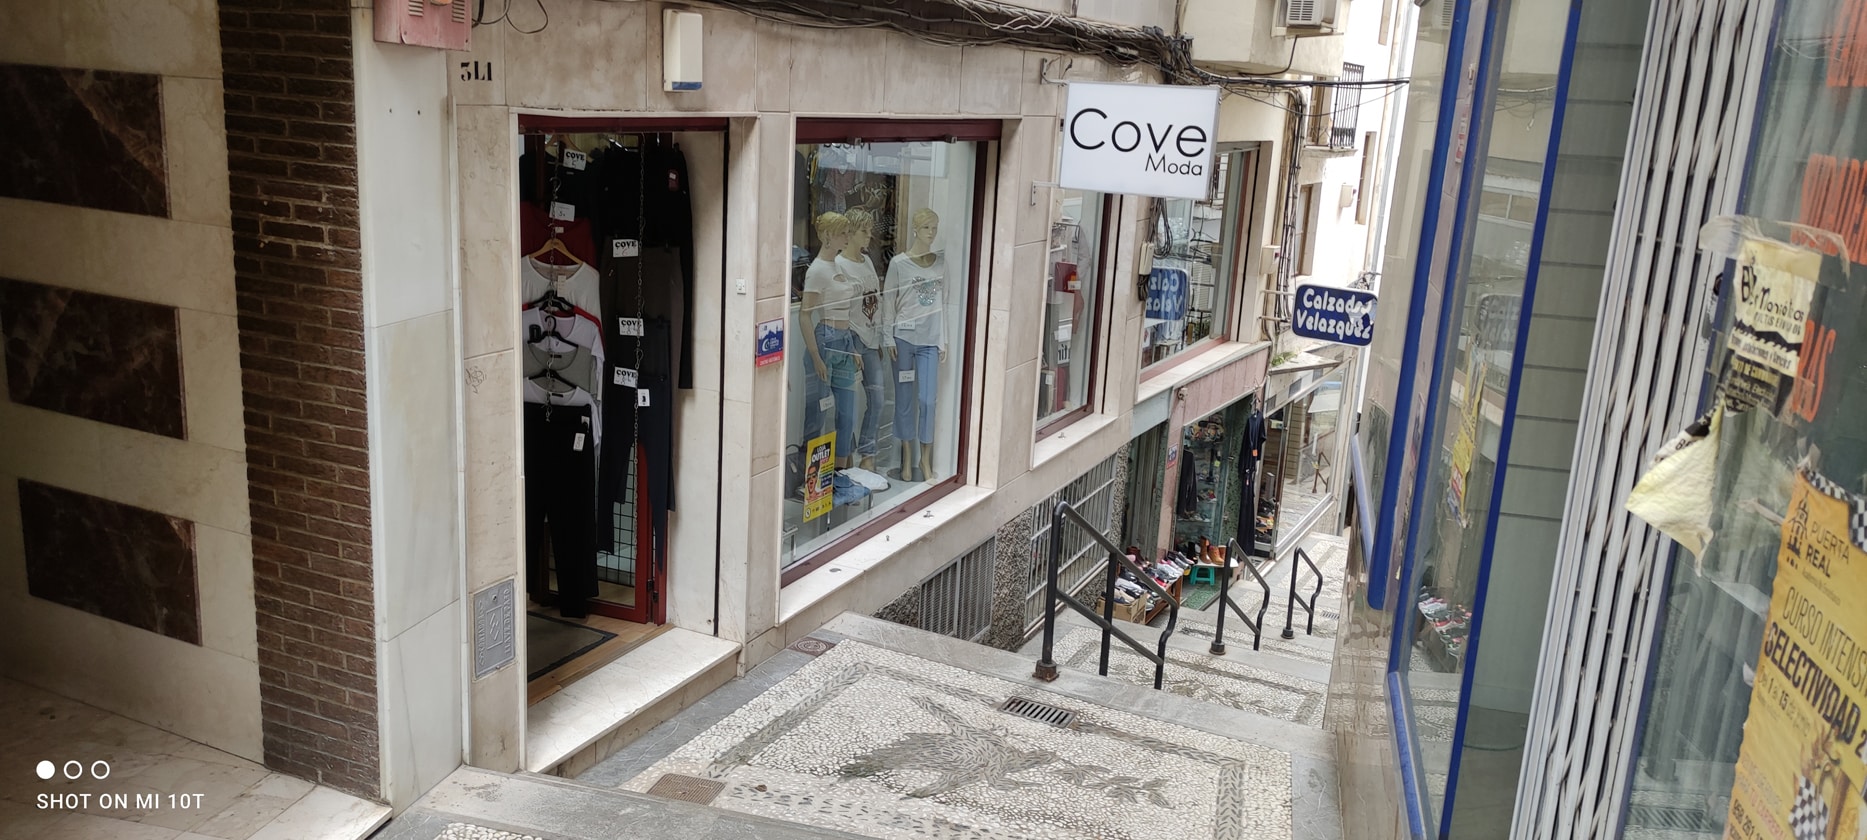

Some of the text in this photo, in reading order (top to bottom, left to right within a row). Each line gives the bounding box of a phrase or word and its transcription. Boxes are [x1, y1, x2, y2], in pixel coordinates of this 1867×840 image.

[1070, 108, 1207, 158] Cove
[566, 151, 585, 161] COVE
[1145, 153, 1203, 176] Moda
[615, 240, 637, 248] COVE
[811, 449, 830, 462] OUTLET
[1811, 521, 1850, 565] PUERTA
[1806, 543, 1831, 578] REAL
[1782, 586, 1824, 646] CURSO
[1764, 621, 1861, 746] SELECTIVIDAD
[1779, 690, 1789, 710] 15
